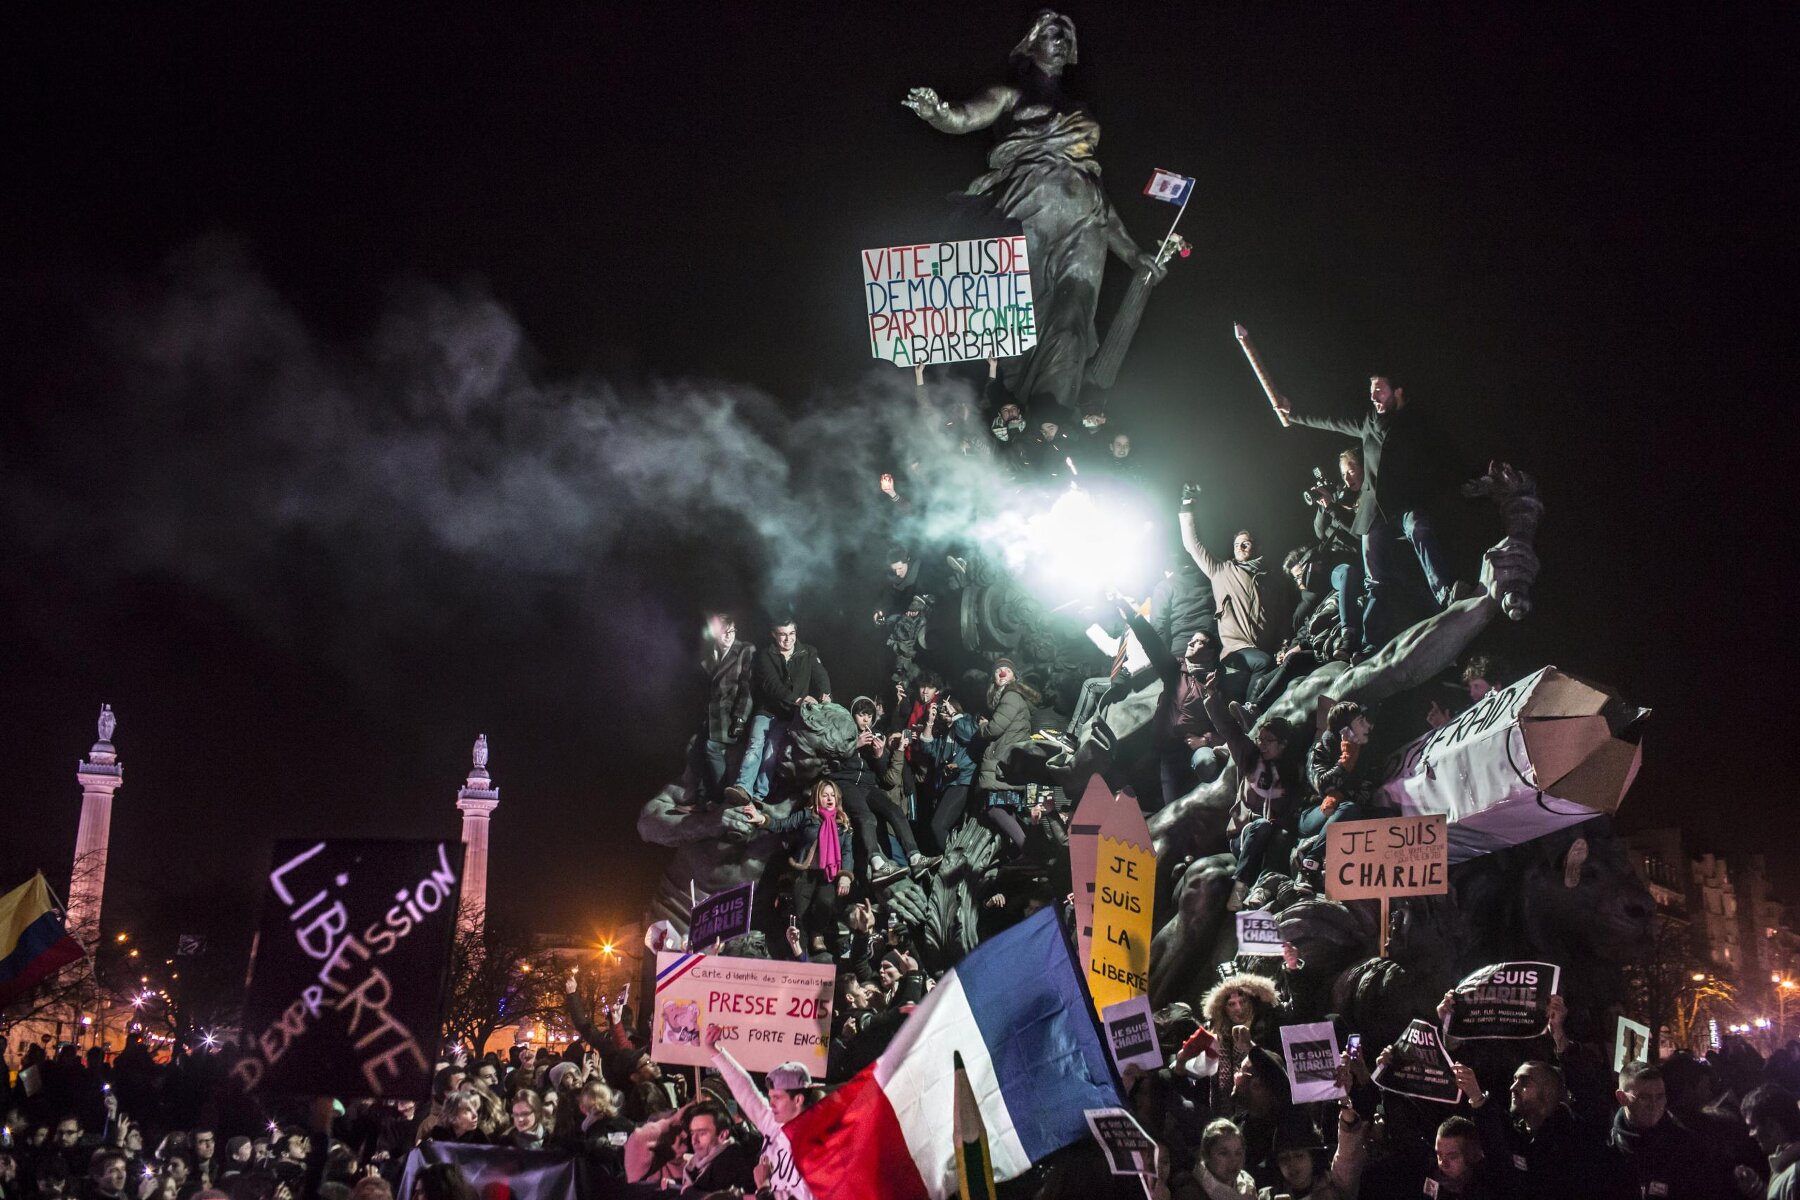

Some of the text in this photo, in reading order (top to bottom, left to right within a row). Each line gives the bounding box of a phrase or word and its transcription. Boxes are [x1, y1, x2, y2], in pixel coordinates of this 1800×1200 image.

[939, 240, 999, 276] PLUS
[997, 238, 1029, 274] DE
[870, 302, 1036, 341] PARTOUT CONTRE
[1340, 830, 1377, 855] JE
[1388, 822, 1437, 848] SUIS
[1110, 857, 1138, 880] JE
[1339, 863, 1442, 887] CHARLIE
[712, 898, 744, 917] SUIS
[1244, 920, 1277, 930] JE SU
[1107, 925, 1131, 950] LA
[1244, 930, 1281, 943] CHARL
[690, 967, 720, 979] Carte
[763, 975, 775, 983] des
[1493, 970, 1538, 985] SUIS
[708, 991, 830, 1020] PRESSE 2015
[749, 1028, 785, 1044] FORTE
[1112, 1022, 1149, 1039] JE SUIS
[1293, 1049, 1333, 1061] JE SUIS
